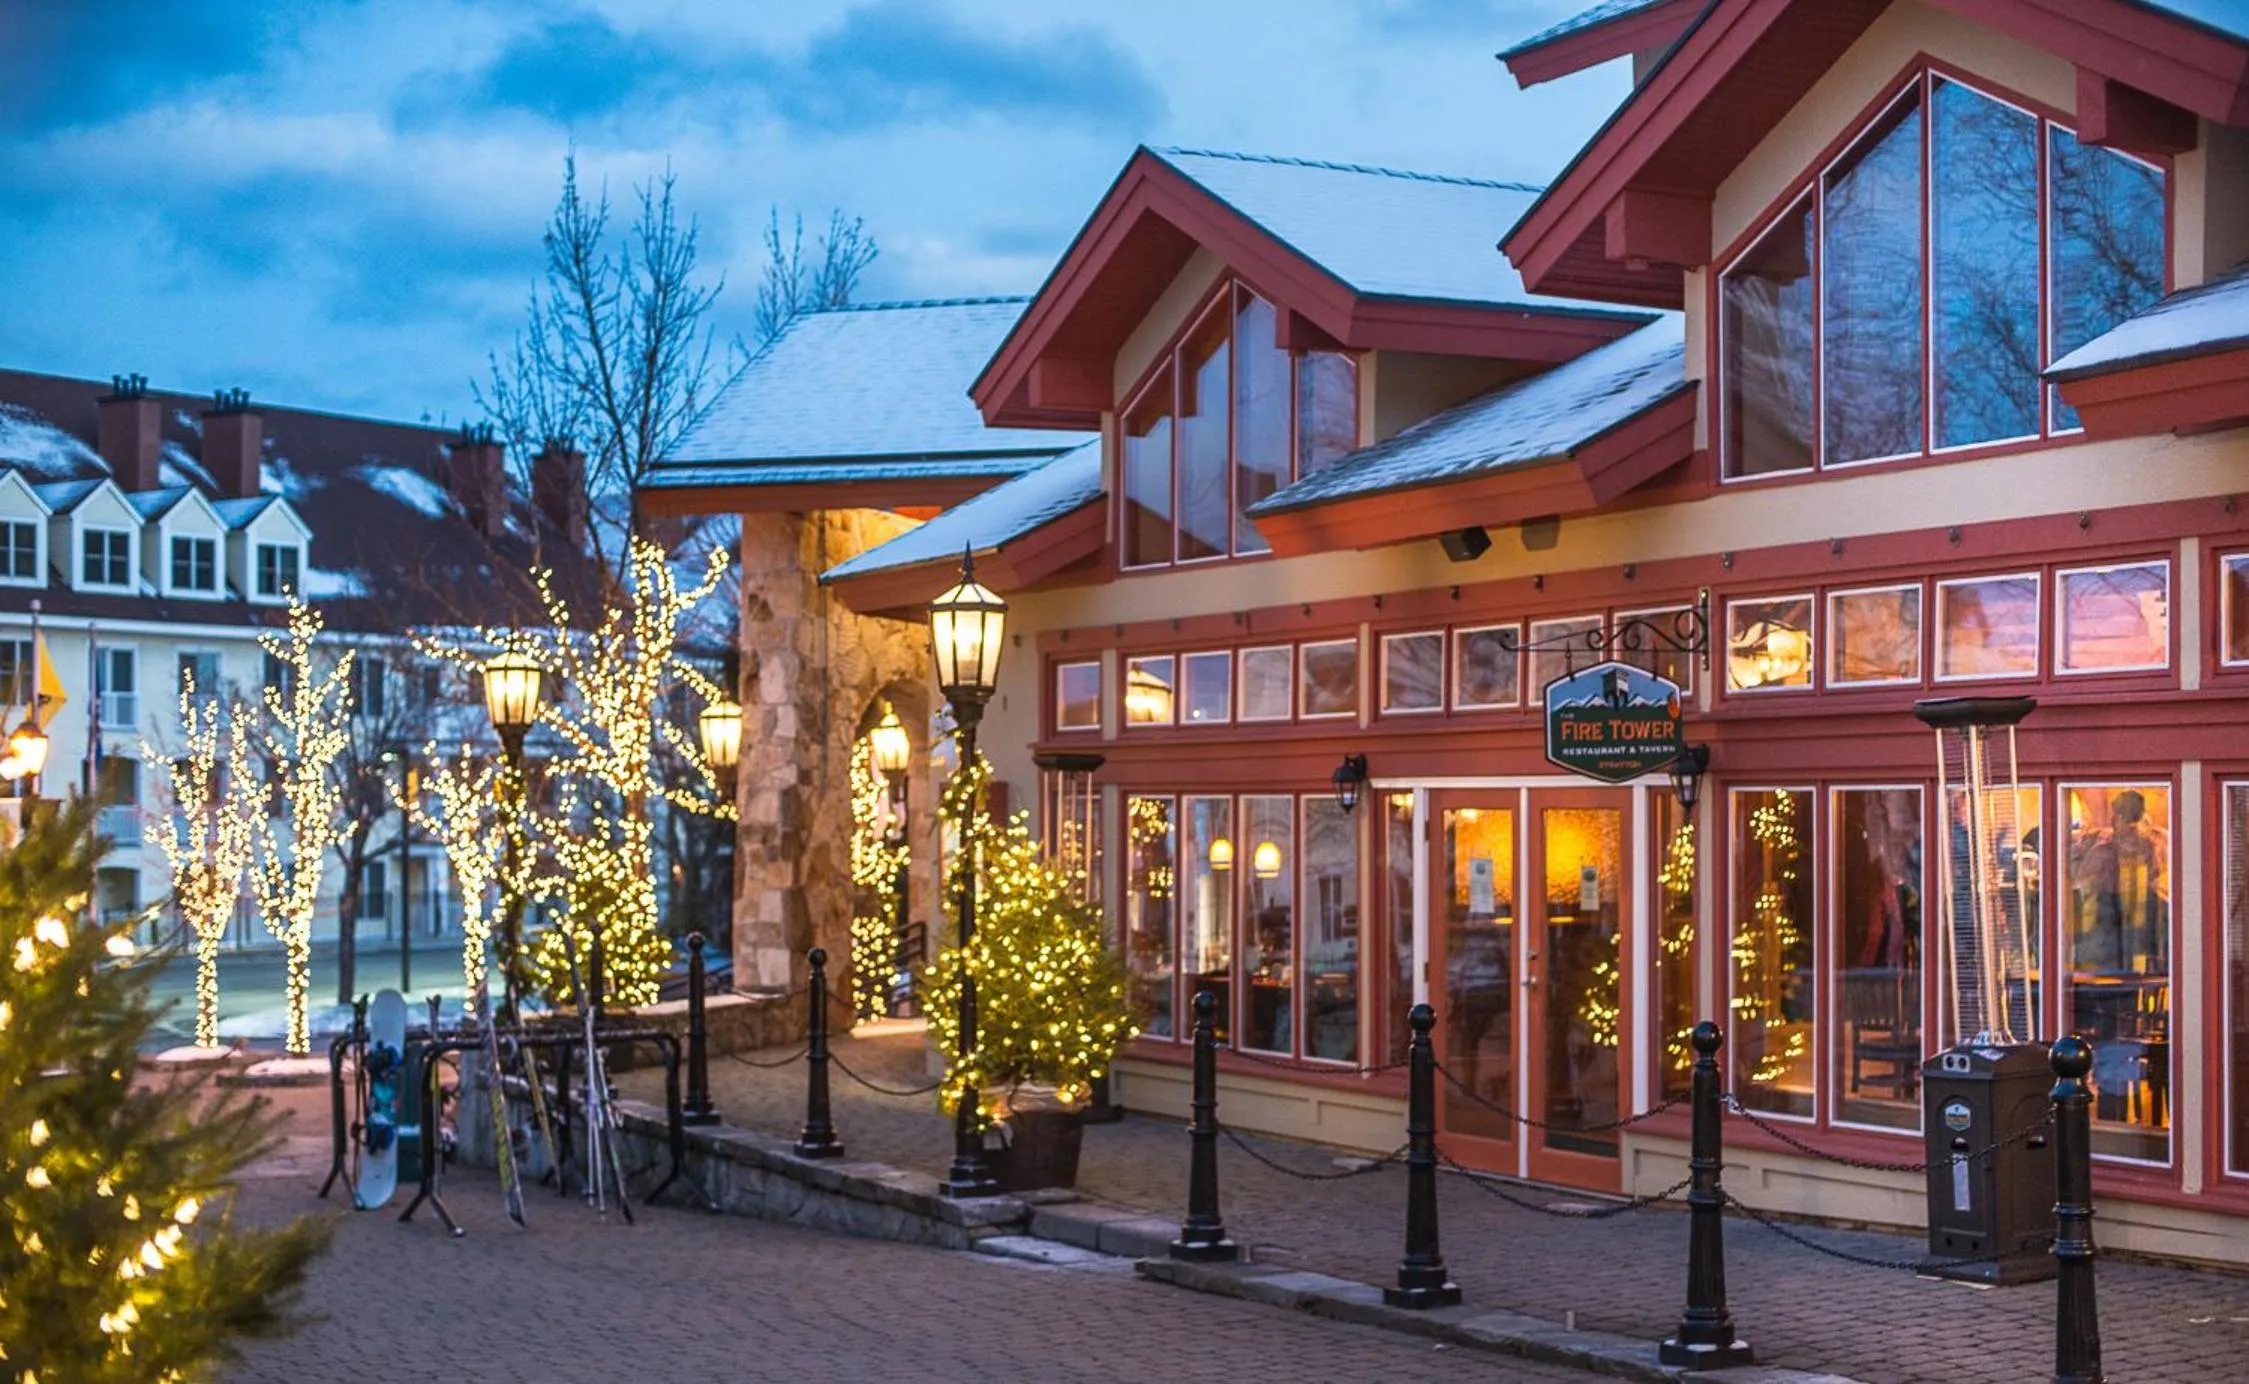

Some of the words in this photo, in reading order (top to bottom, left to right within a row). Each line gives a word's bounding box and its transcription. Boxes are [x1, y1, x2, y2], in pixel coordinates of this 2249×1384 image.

[1561, 721, 1604, 741] FIRE
[1608, 719, 1675, 740] TOWER
[1563, 746, 1627, 755] RESTAURANT
[1639, 745, 1676, 753] TAVERN
